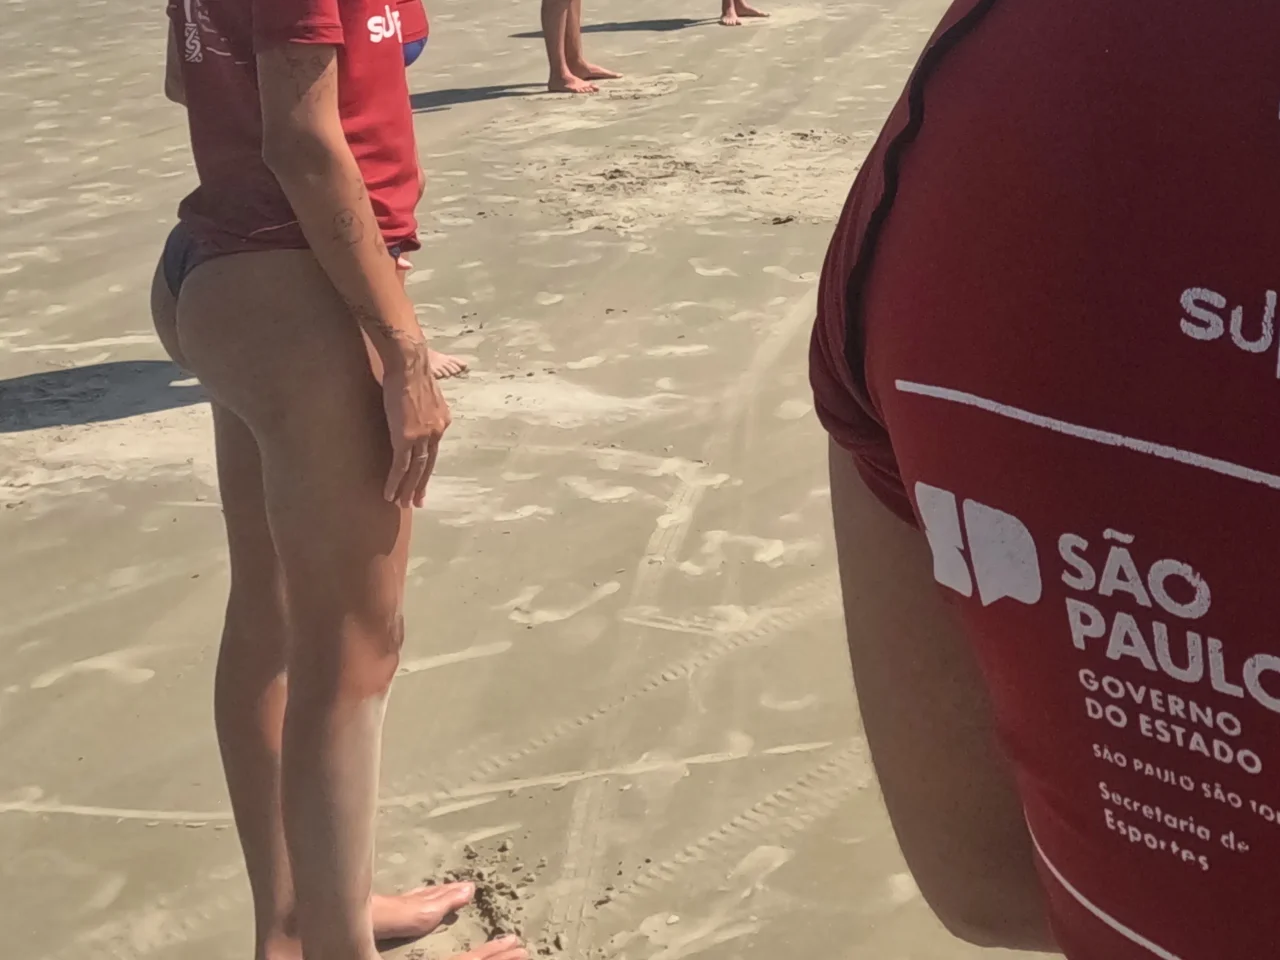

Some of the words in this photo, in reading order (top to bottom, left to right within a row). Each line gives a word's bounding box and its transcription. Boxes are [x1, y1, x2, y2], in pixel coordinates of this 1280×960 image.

[1056, 528, 1212, 620] SÃO
[1078, 667, 1243, 738] GOVERNO
[1085, 696, 1128, 728] DO
[1139, 714, 1263, 775] ESTADO
[1092, 742, 1128, 768] SÃO
[1132, 757, 1195, 792] PAULO
[1201, 782, 1243, 809] SÃO
[1098, 781, 1212, 842] Secretaria
[1220, 830, 1250, 853] de
[1103, 807, 1211, 872] Esportes
